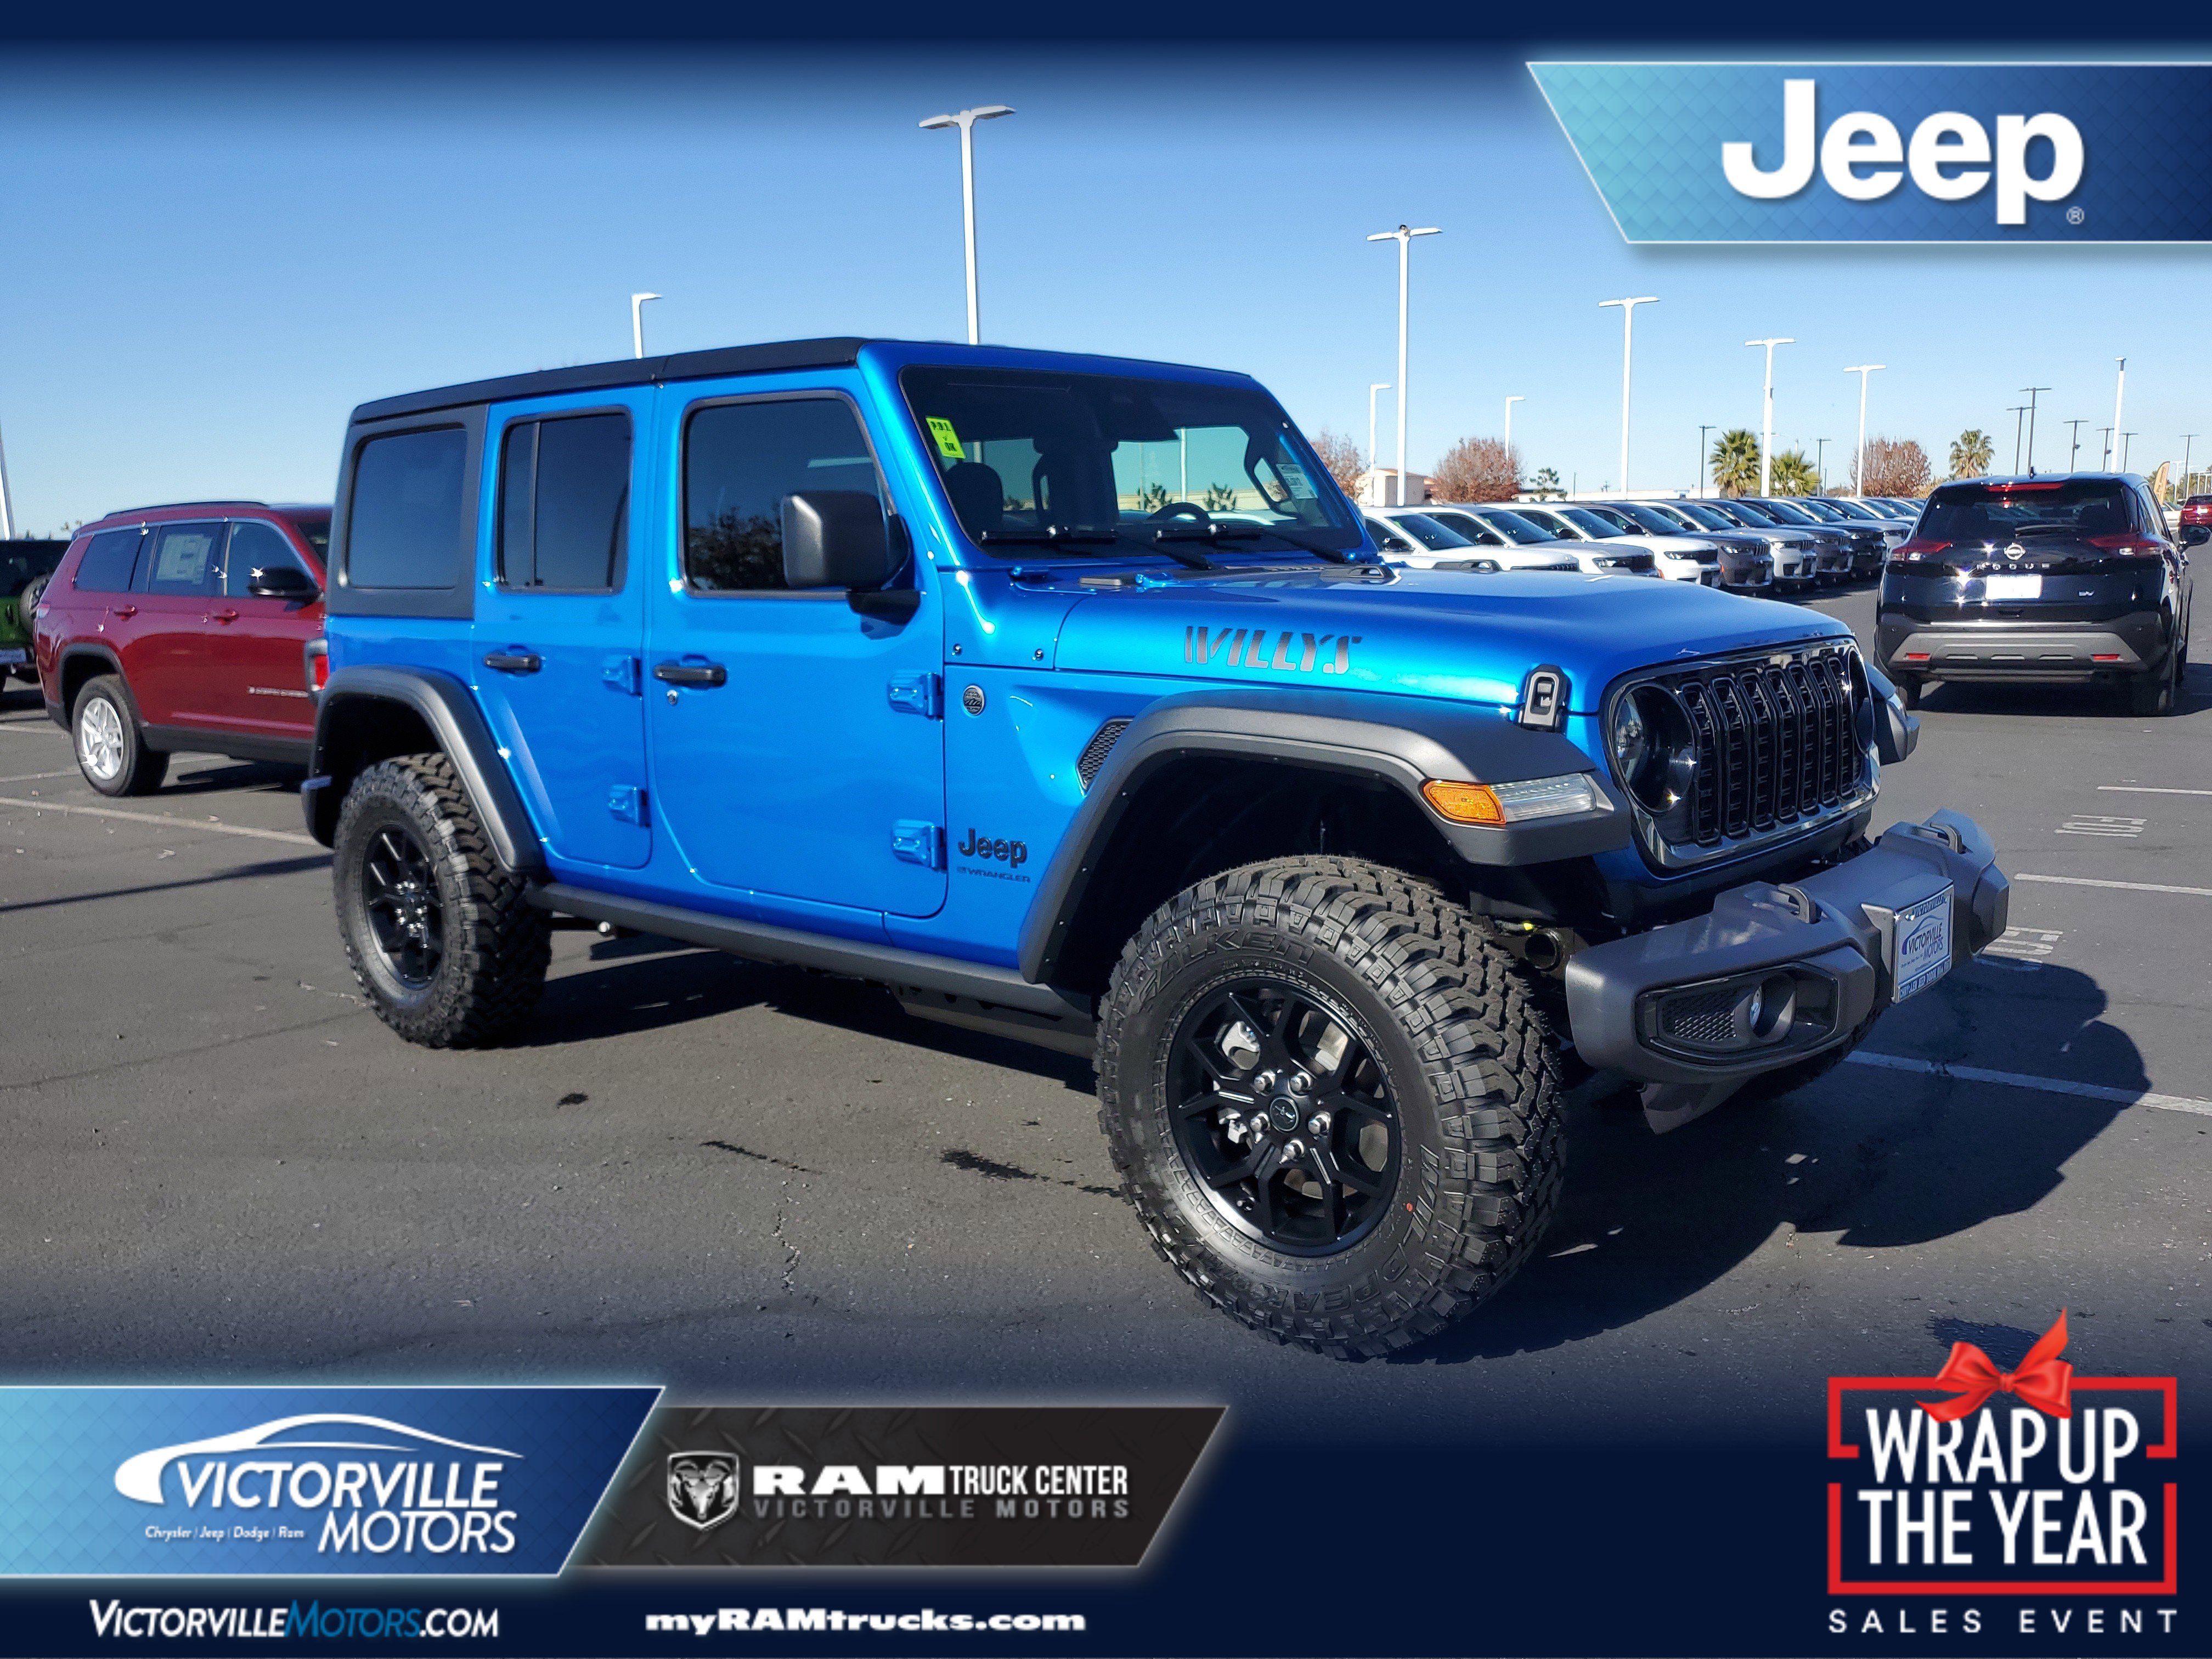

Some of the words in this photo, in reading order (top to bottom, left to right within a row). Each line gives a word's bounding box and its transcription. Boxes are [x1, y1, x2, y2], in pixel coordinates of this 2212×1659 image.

[1184, 625, 1363, 674] WILLYS
[958, 828, 1028, 868] Jeep
[1908, 922, 1943, 955] VICTORVILLE
[1923, 936, 1944, 961] MOTORS
